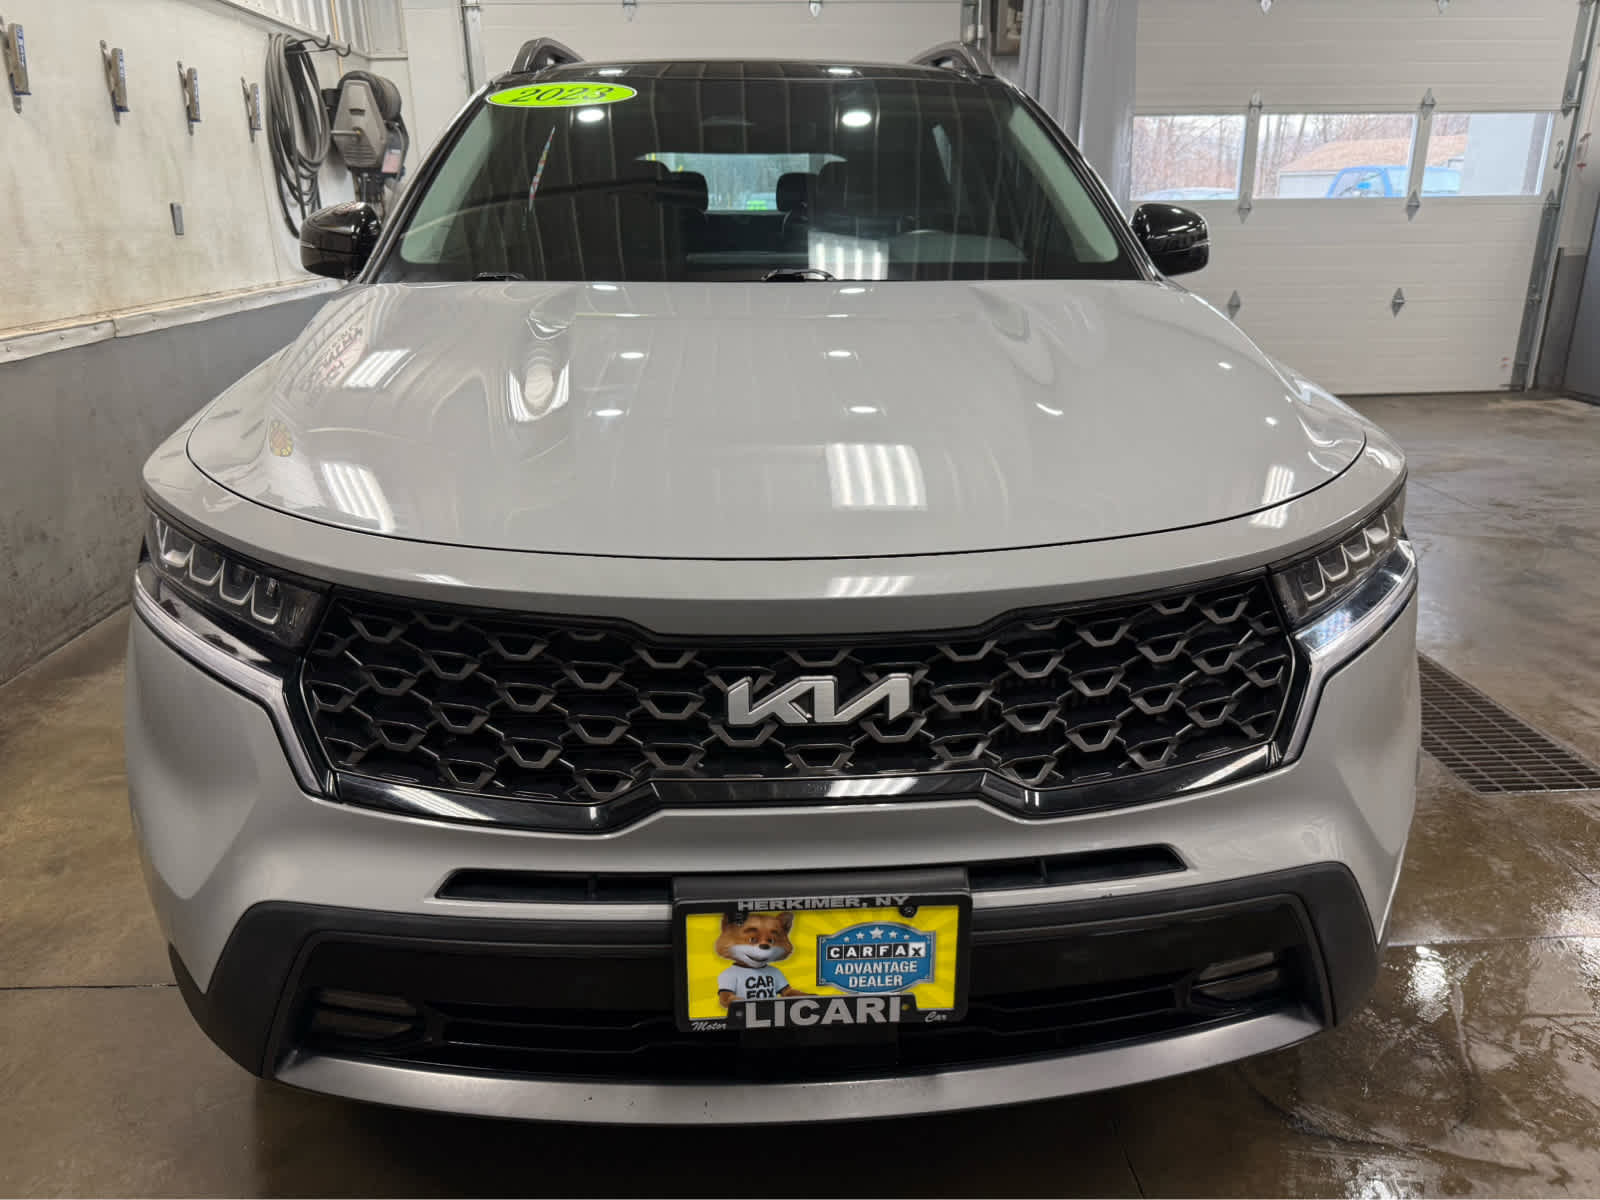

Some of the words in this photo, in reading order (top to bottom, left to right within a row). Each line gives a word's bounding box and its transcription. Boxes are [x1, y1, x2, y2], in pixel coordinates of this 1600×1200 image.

[509, 87, 614, 103] 2023
[728, 673, 913, 726] KIA
[738, 897, 868, 911] HERKIMER,
[875, 895, 911, 907] NY
[828, 943, 925, 959] CARFAX
[834, 960, 918, 975] ADVANTAGE
[745, 975, 775, 990] CAR
[849, 974, 903, 988] DEALER
[745, 996, 901, 1028] LICARI
[691, 1021, 727, 1032] Motor
[925, 1011, 948, 1023] Car
